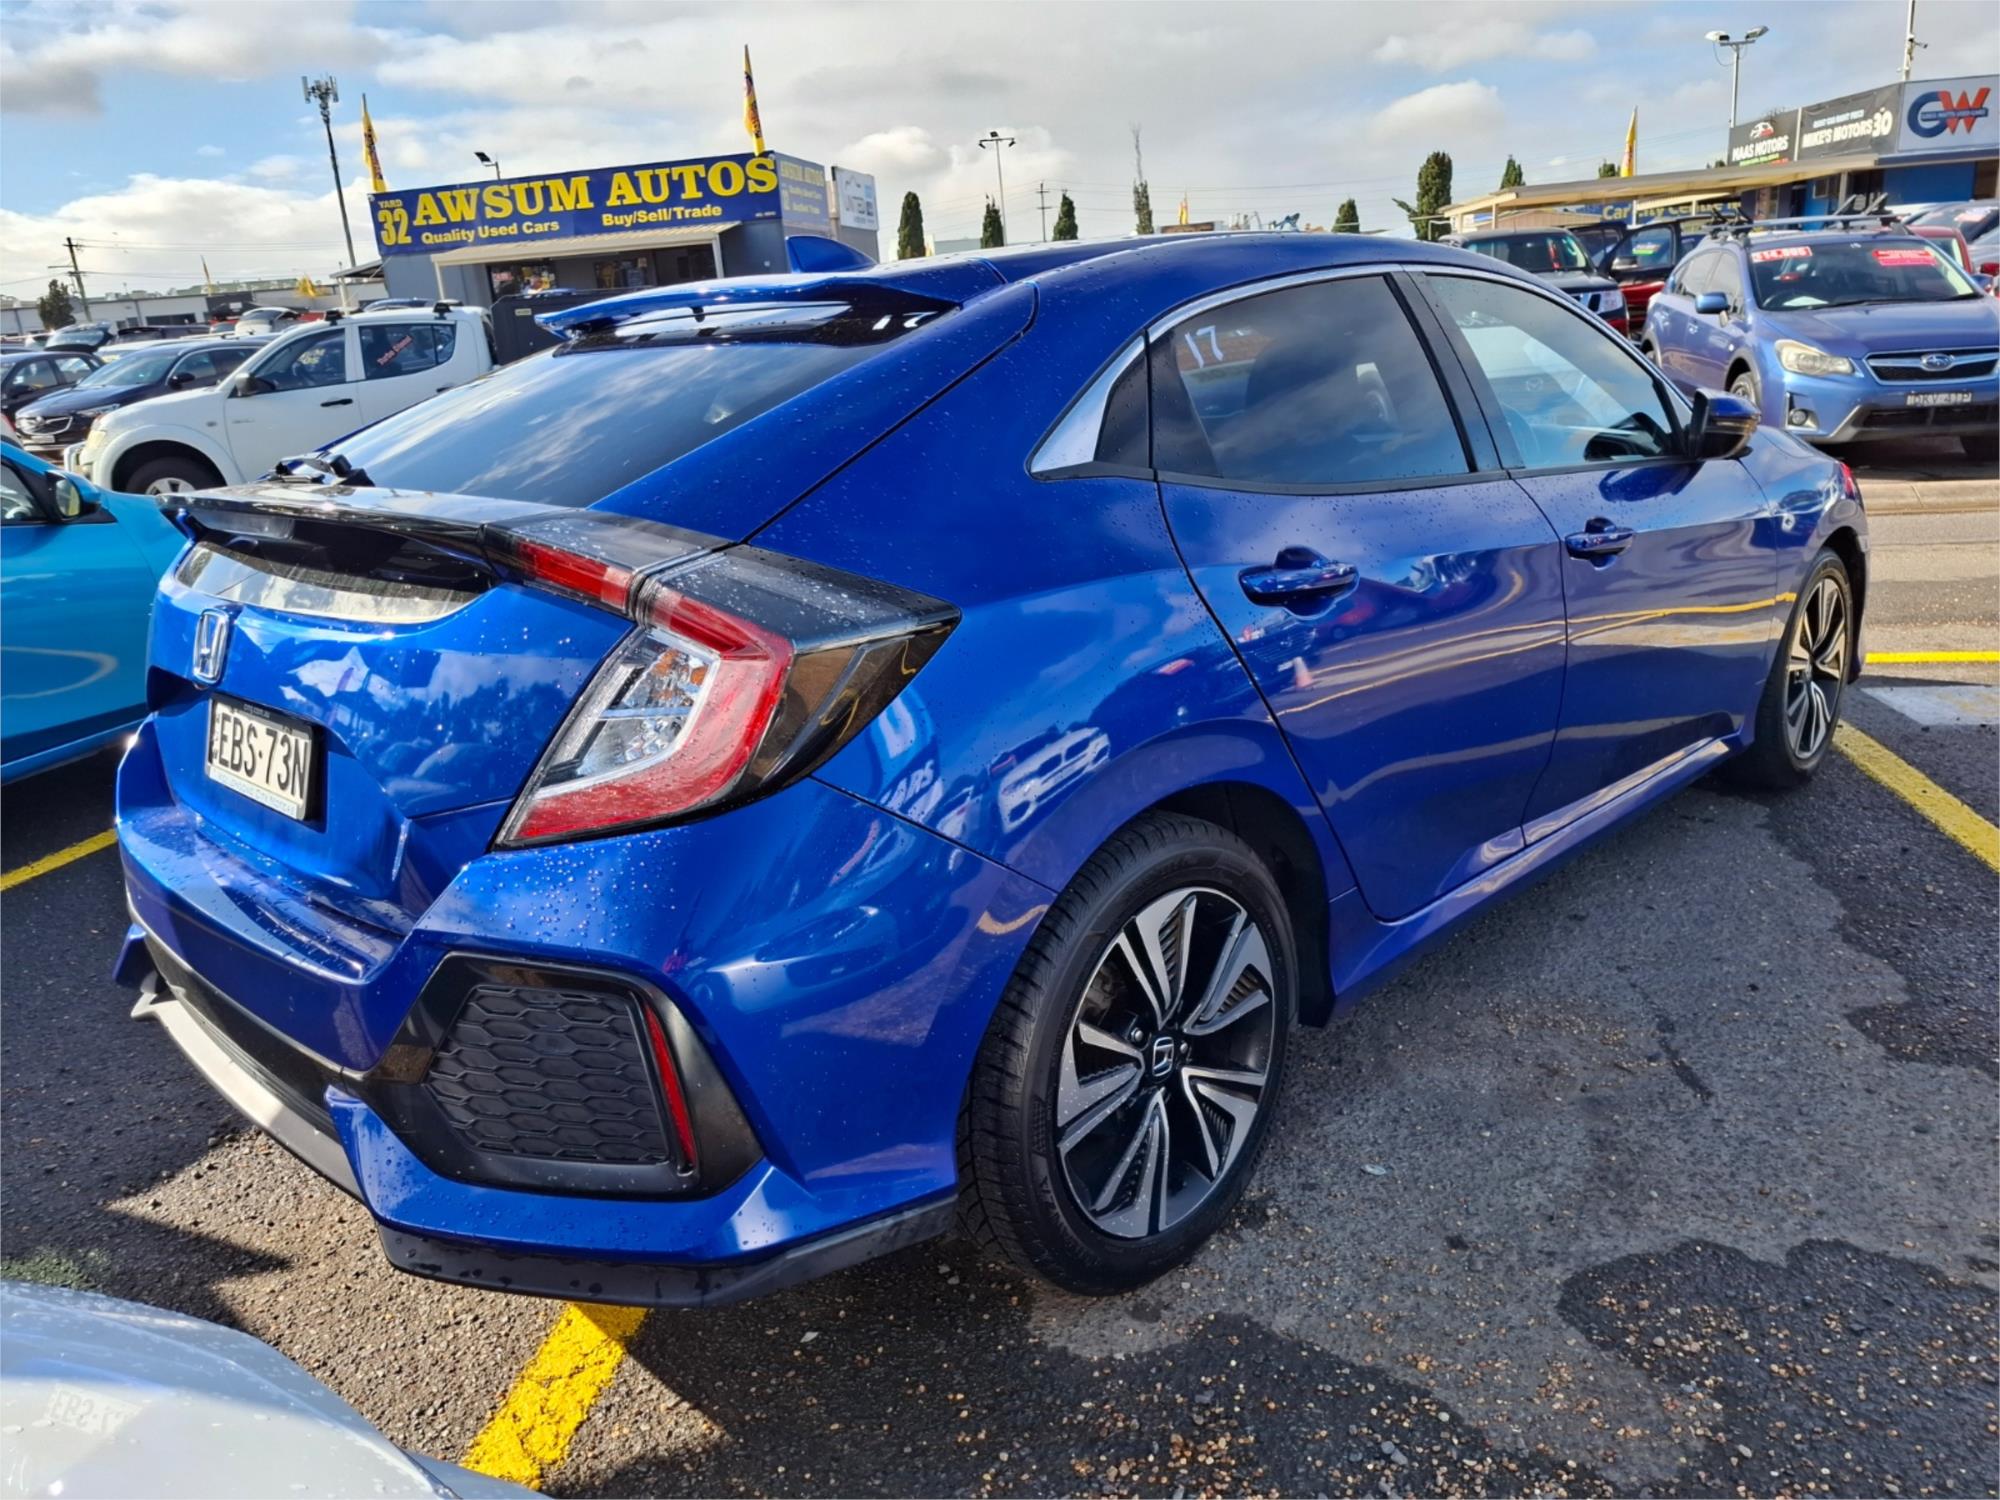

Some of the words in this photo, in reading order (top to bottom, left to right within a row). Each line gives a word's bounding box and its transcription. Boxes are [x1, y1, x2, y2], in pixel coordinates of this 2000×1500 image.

[1907, 87, 1992, 138] GW
[1802, 128, 1833, 148] MIKE'S
[1833, 119, 1872, 142] MOTORS
[1872, 109, 1893, 137] 30
[1755, 135, 1789, 157] MOTORS
[378, 199, 402, 209] YARD
[413, 176, 594, 226] AWSUM
[606, 156, 779, 208] AUTOS
[378, 209, 412, 246] 32
[602, 204, 723, 228] Buy/Sell/Trade
[1602, 204, 1632, 221] Car
[420, 227, 476, 245] Quality
[478, 223, 518, 239] Used
[522, 220, 560, 234] Cars
[1184, 325, 1224, 369] 17
